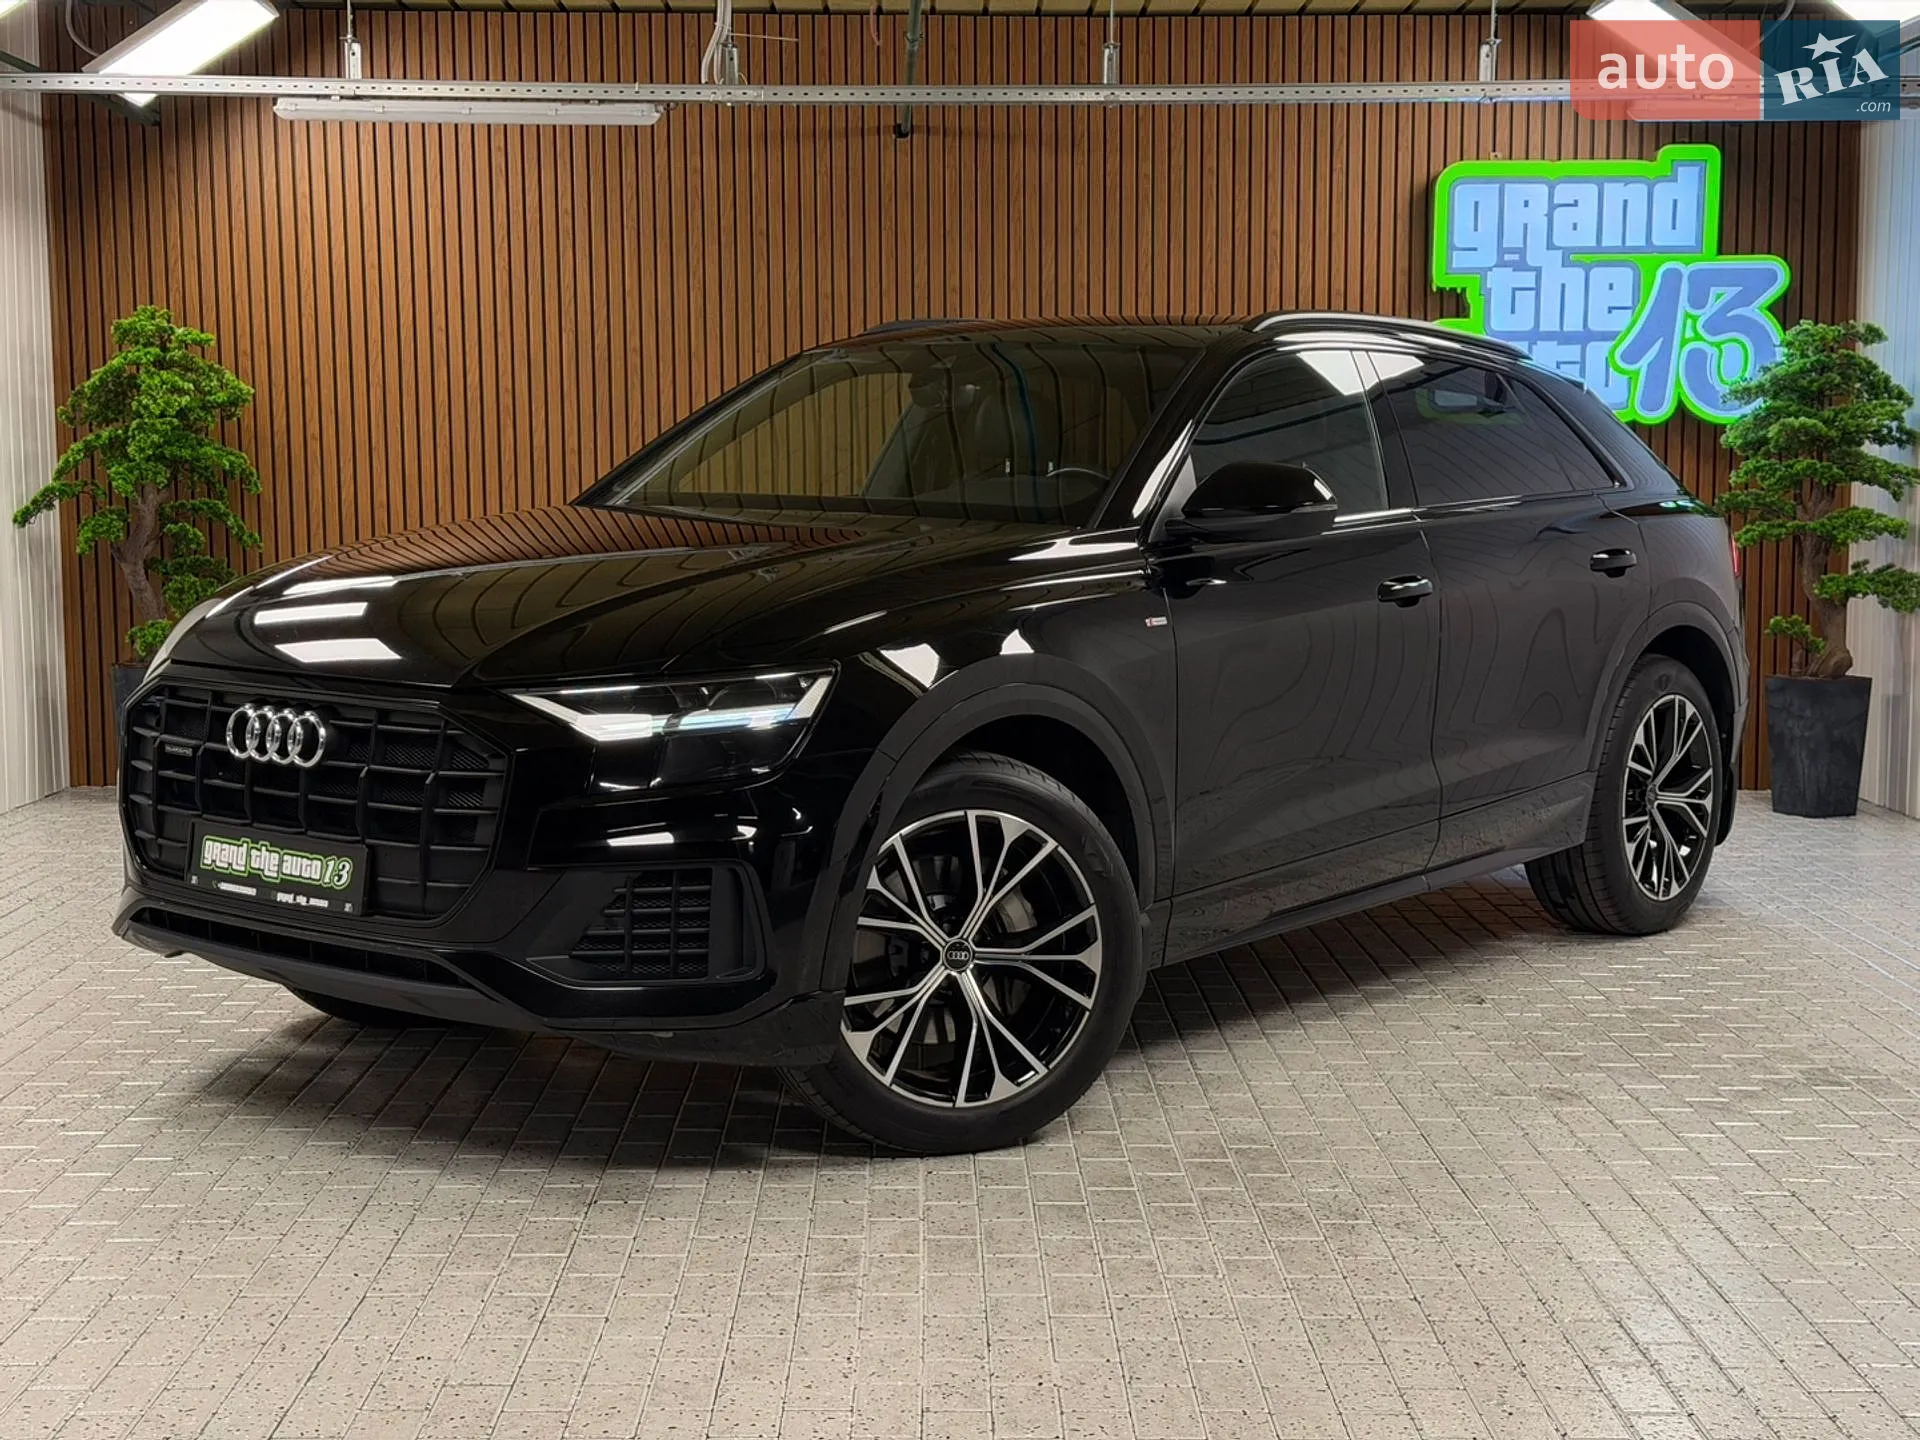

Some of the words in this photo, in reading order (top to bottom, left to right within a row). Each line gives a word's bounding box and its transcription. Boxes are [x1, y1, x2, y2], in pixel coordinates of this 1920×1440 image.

[1486, 254, 1637, 332] the
[1617, 261, 1785, 417] 13
[250, 845, 280, 877] the
[282, 854, 323, 880] auto
[323, 858, 351, 887] 13
